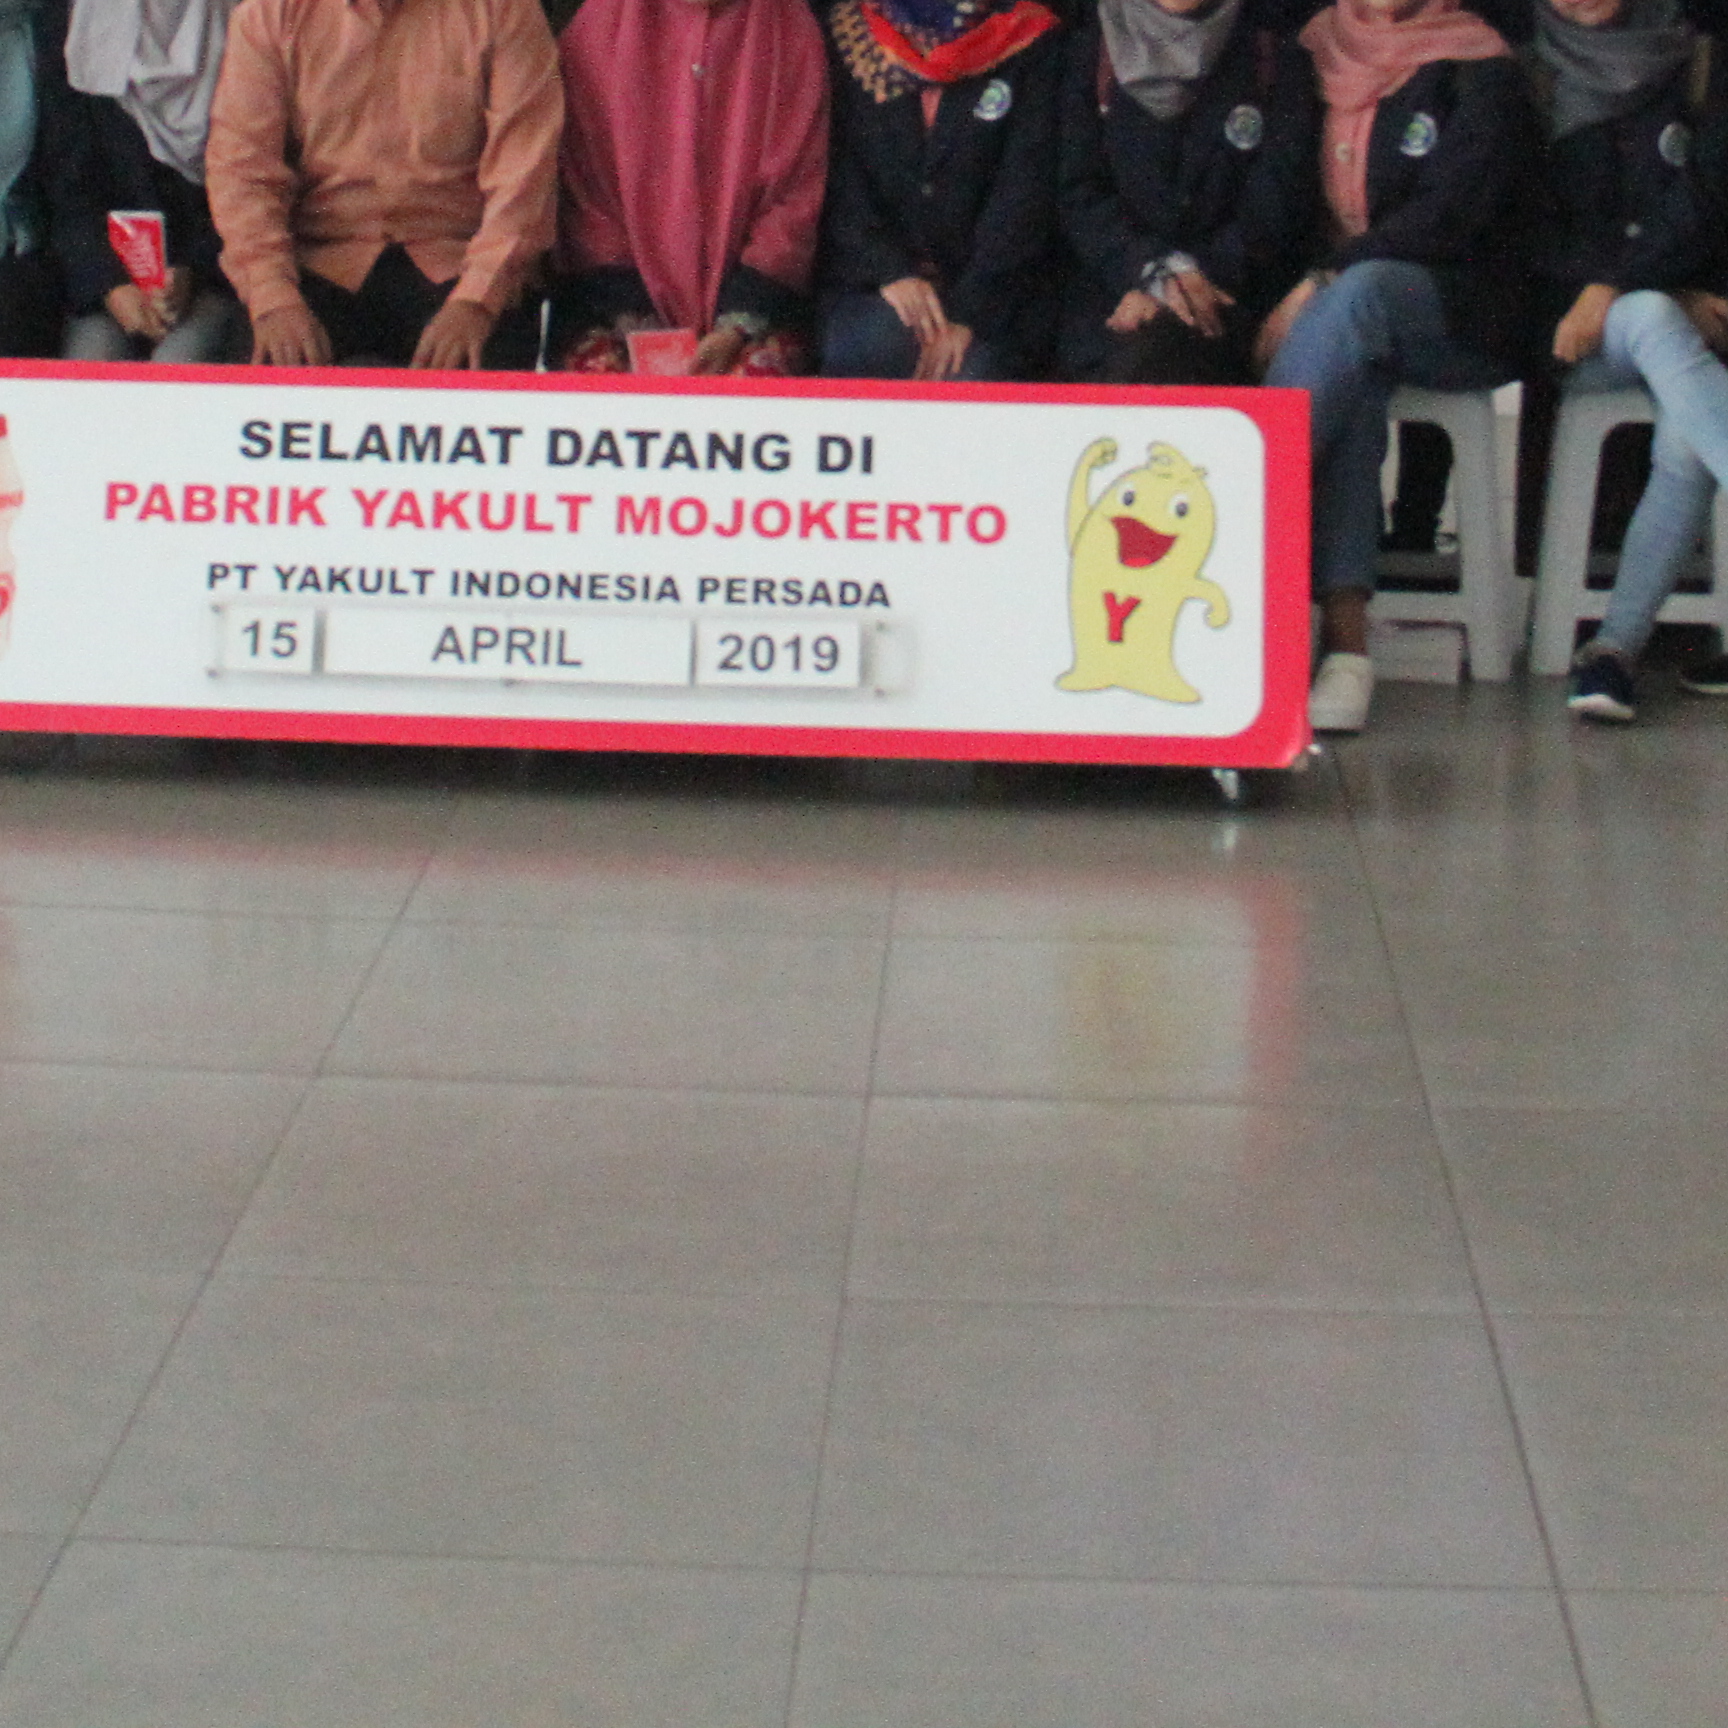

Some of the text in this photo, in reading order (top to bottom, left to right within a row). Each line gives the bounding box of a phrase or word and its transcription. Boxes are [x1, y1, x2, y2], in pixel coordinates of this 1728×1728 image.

[240, 420, 874, 474] SELAMAT DATANG DI
[104, 481, 1008, 545] PABRIK YAKULT MOJOKERTO
[206, 563, 891, 608] PT YAKULT INDONESIA PERSADA
[1102, 590, 1143, 644] Y
[241, 620, 841, 673] 15 APRIL 2019
